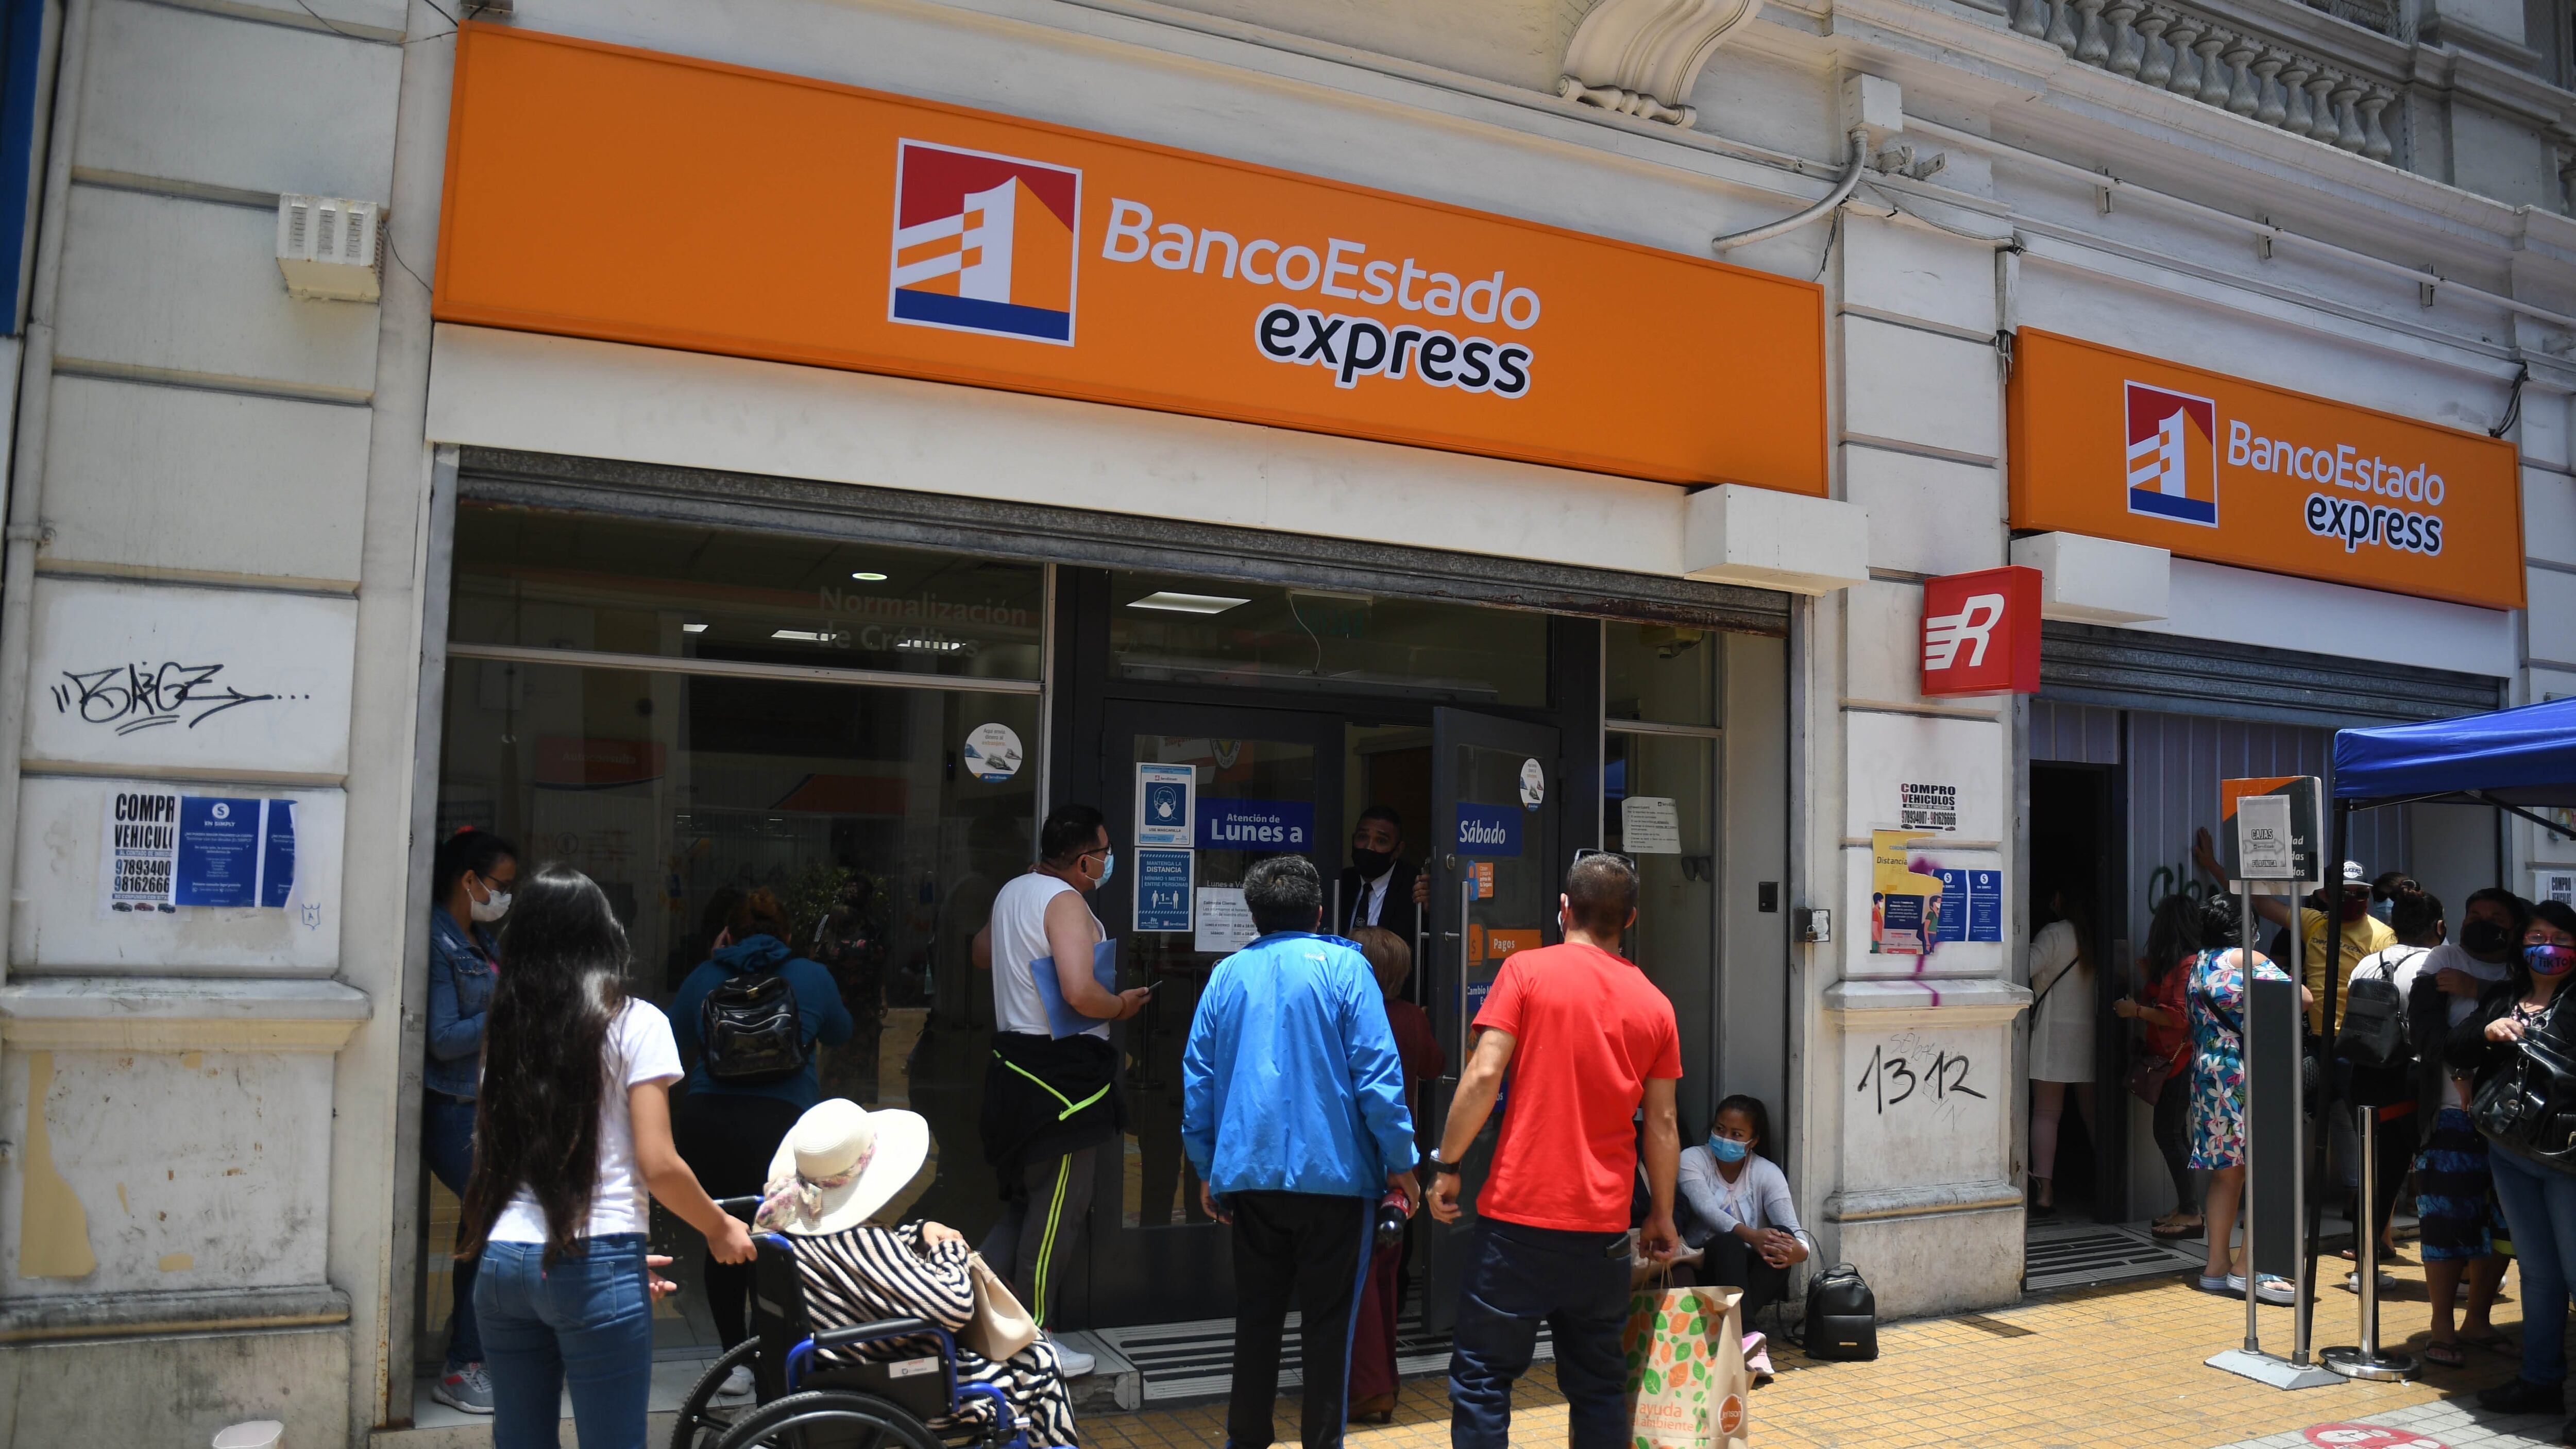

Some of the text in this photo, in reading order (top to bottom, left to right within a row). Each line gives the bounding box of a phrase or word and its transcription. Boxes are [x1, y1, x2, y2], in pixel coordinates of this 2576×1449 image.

[1103, 197, 1540, 329] BancoEstado
[1257, 306, 1531, 396] express
[2227, 419, 2445, 505] BancoEstado
[2306, 495, 2441, 554] express
[819, 586, 1027, 626] Normalización
[817, 620, 978, 658] de Créditos
[1901, 783, 1956, 795] COMPRO
[1902, 794, 1955, 805] VEHICULOS
[1227, 813, 1280, 823] Atención de
[1212, 819, 1302, 843] Lunes a
[1460, 820, 1506, 844] Sábado
[2251, 828, 2273, 840] CAJAS
[115, 859, 172, 876] 97893400
[1877, 856, 1907, 865] Distancia
[2552, 877, 2571, 891] COMPRO
[1161, 893, 1164, 901] 1
[1494, 938, 1515, 952] Pagos
[1857, 1045, 1987, 1115] 1312
[1639, 1401, 1682, 1418] ayuda
[1641, 1417, 1693, 1431] ambiente
